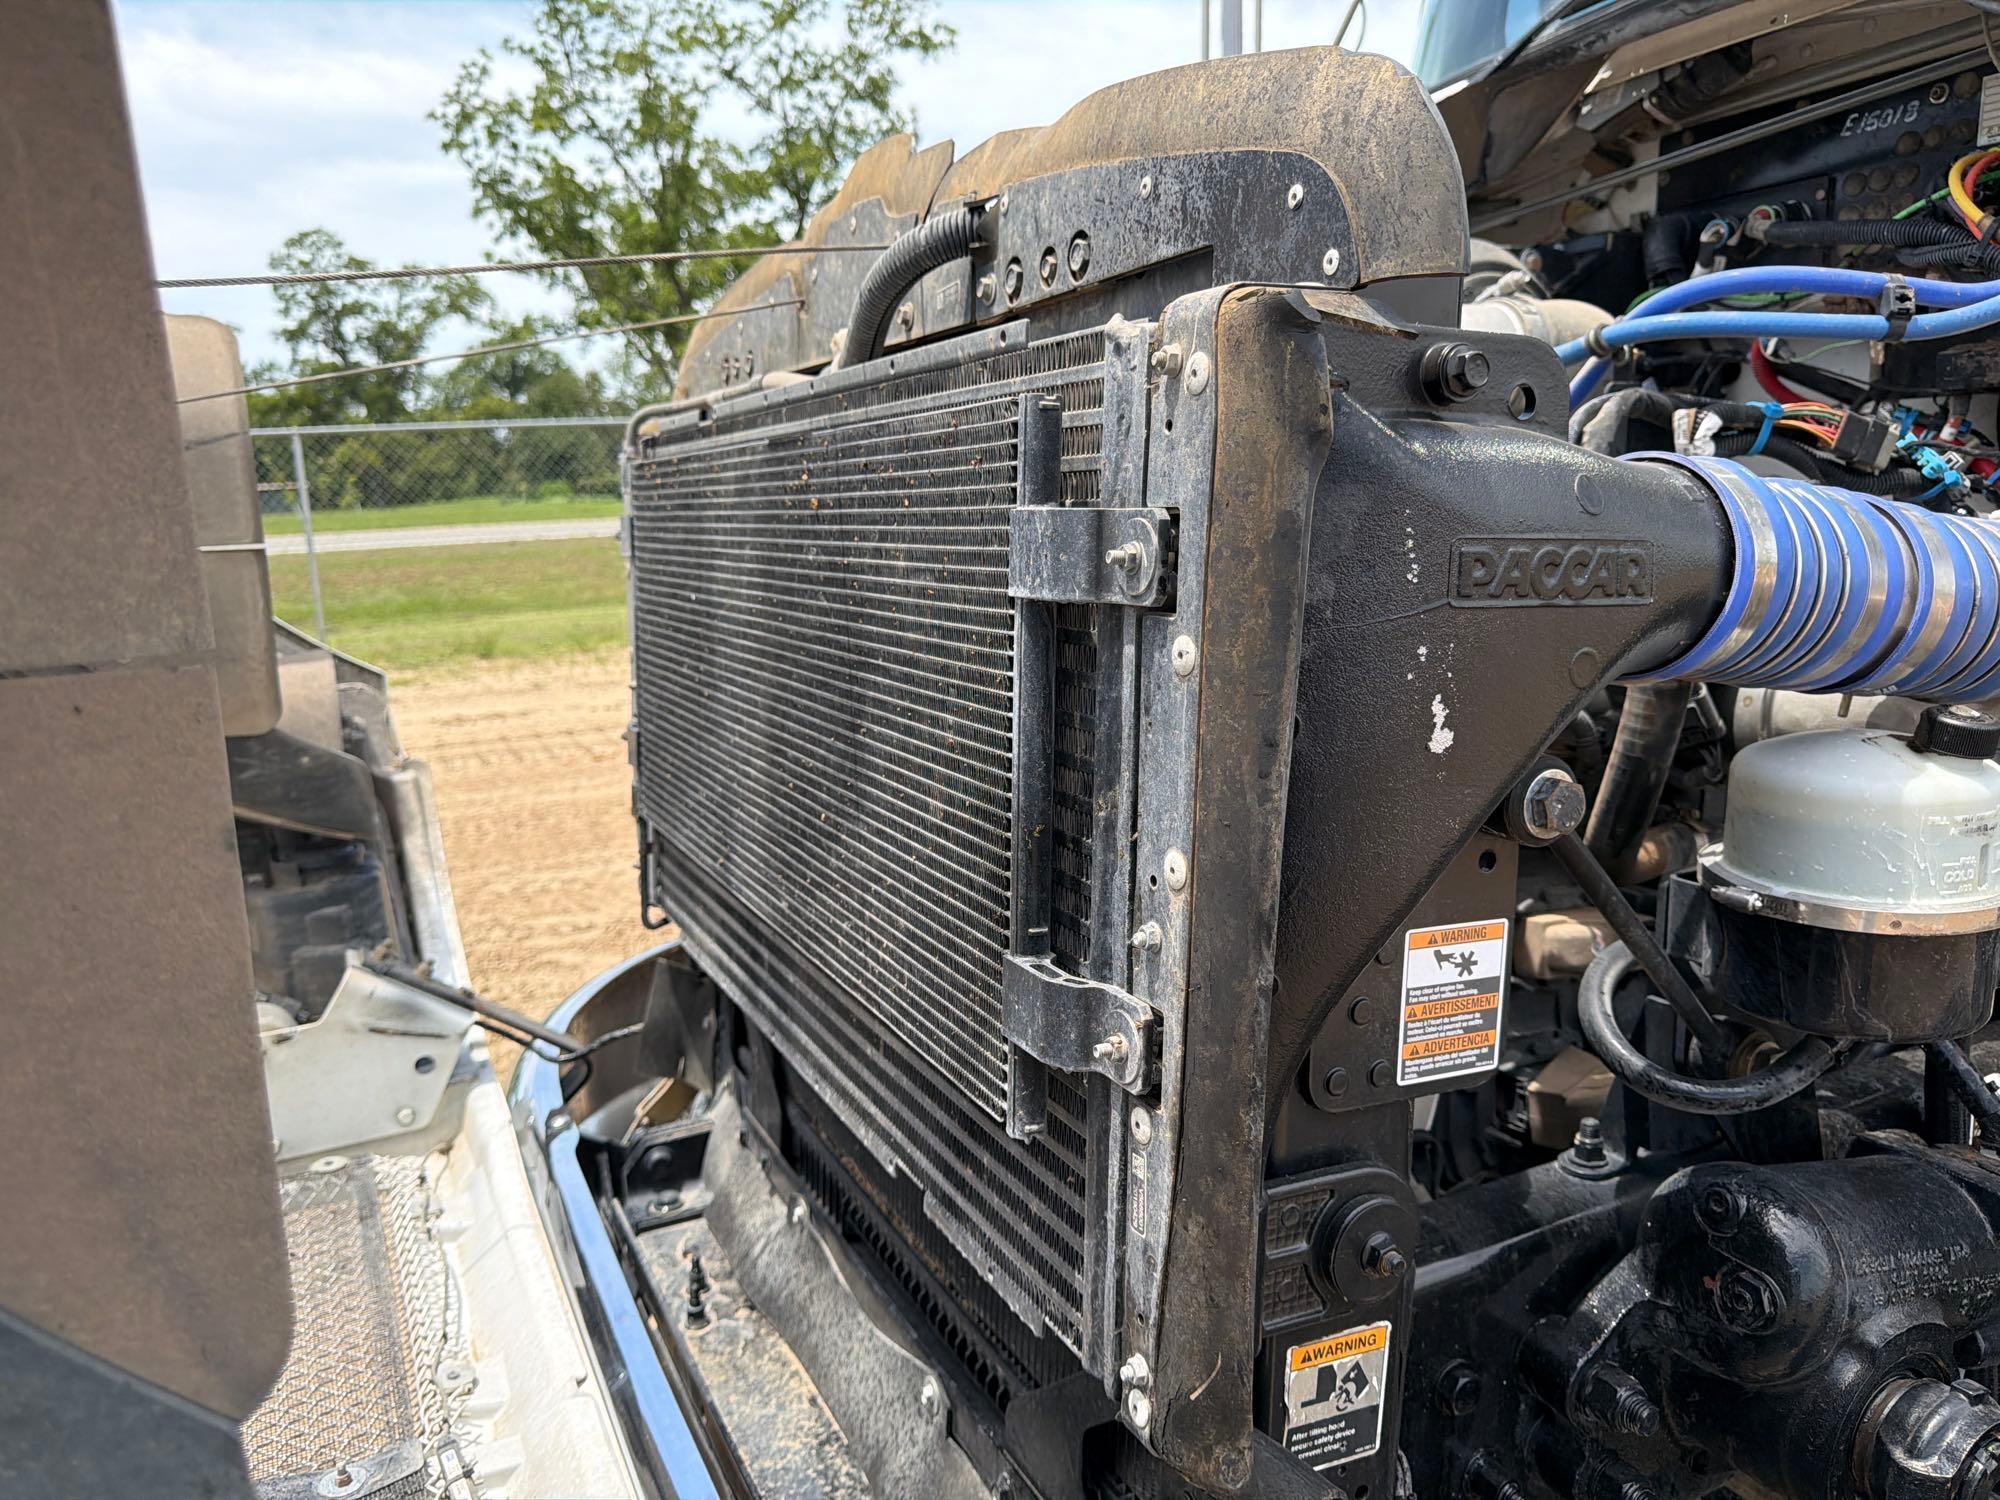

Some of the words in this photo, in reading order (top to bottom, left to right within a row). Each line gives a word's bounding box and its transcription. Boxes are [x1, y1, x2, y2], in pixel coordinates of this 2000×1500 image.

[1457, 543, 1649, 600] PACCAR
[1440, 926, 1487, 944] WARNING
[1420, 994, 1497, 1017] AVERTISSEMENT
[1423, 1032, 1490, 1054] ADVERTENCIA
[1312, 1333, 1377, 1361] WARNING
